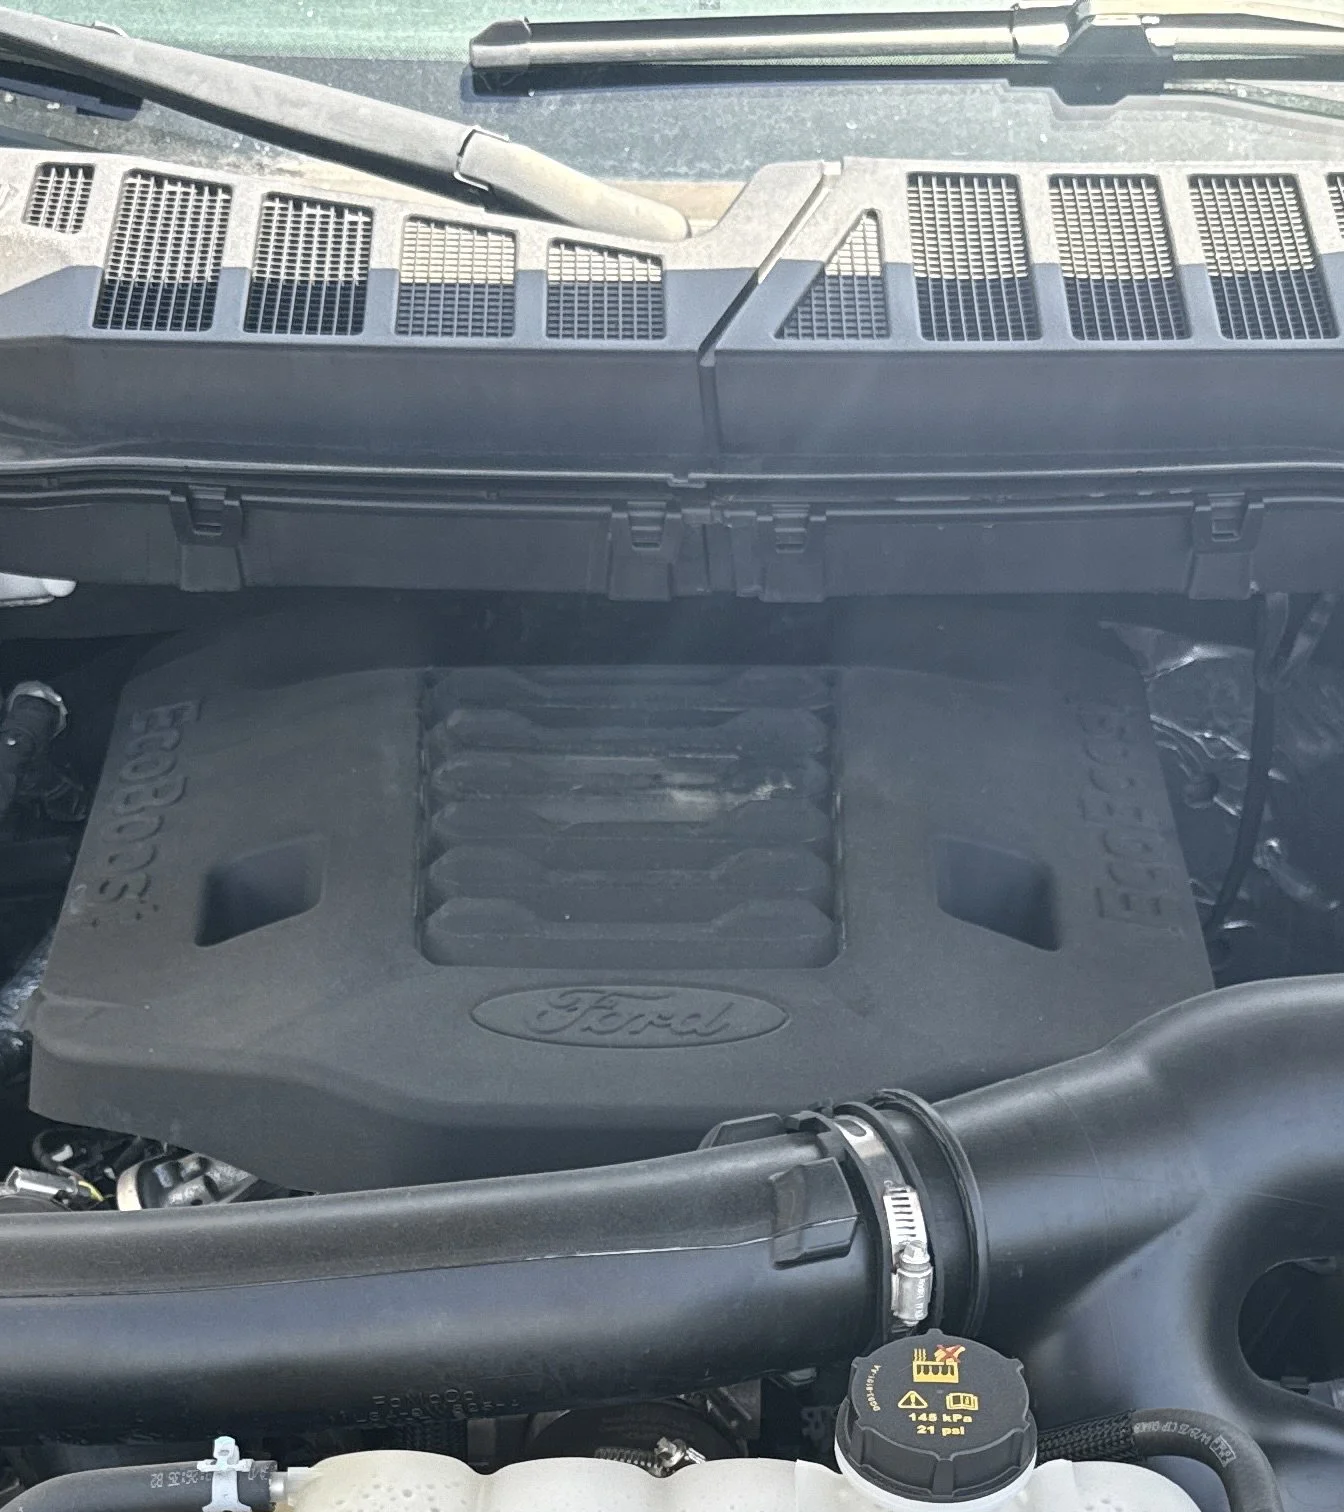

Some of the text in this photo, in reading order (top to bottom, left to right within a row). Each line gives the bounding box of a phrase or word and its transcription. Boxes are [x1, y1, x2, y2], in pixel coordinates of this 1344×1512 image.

[524, 987, 735, 1037] Ford
[908, 1412, 973, 1422] 145 kPa
[916, 1425, 965, 1437] 21 psi
